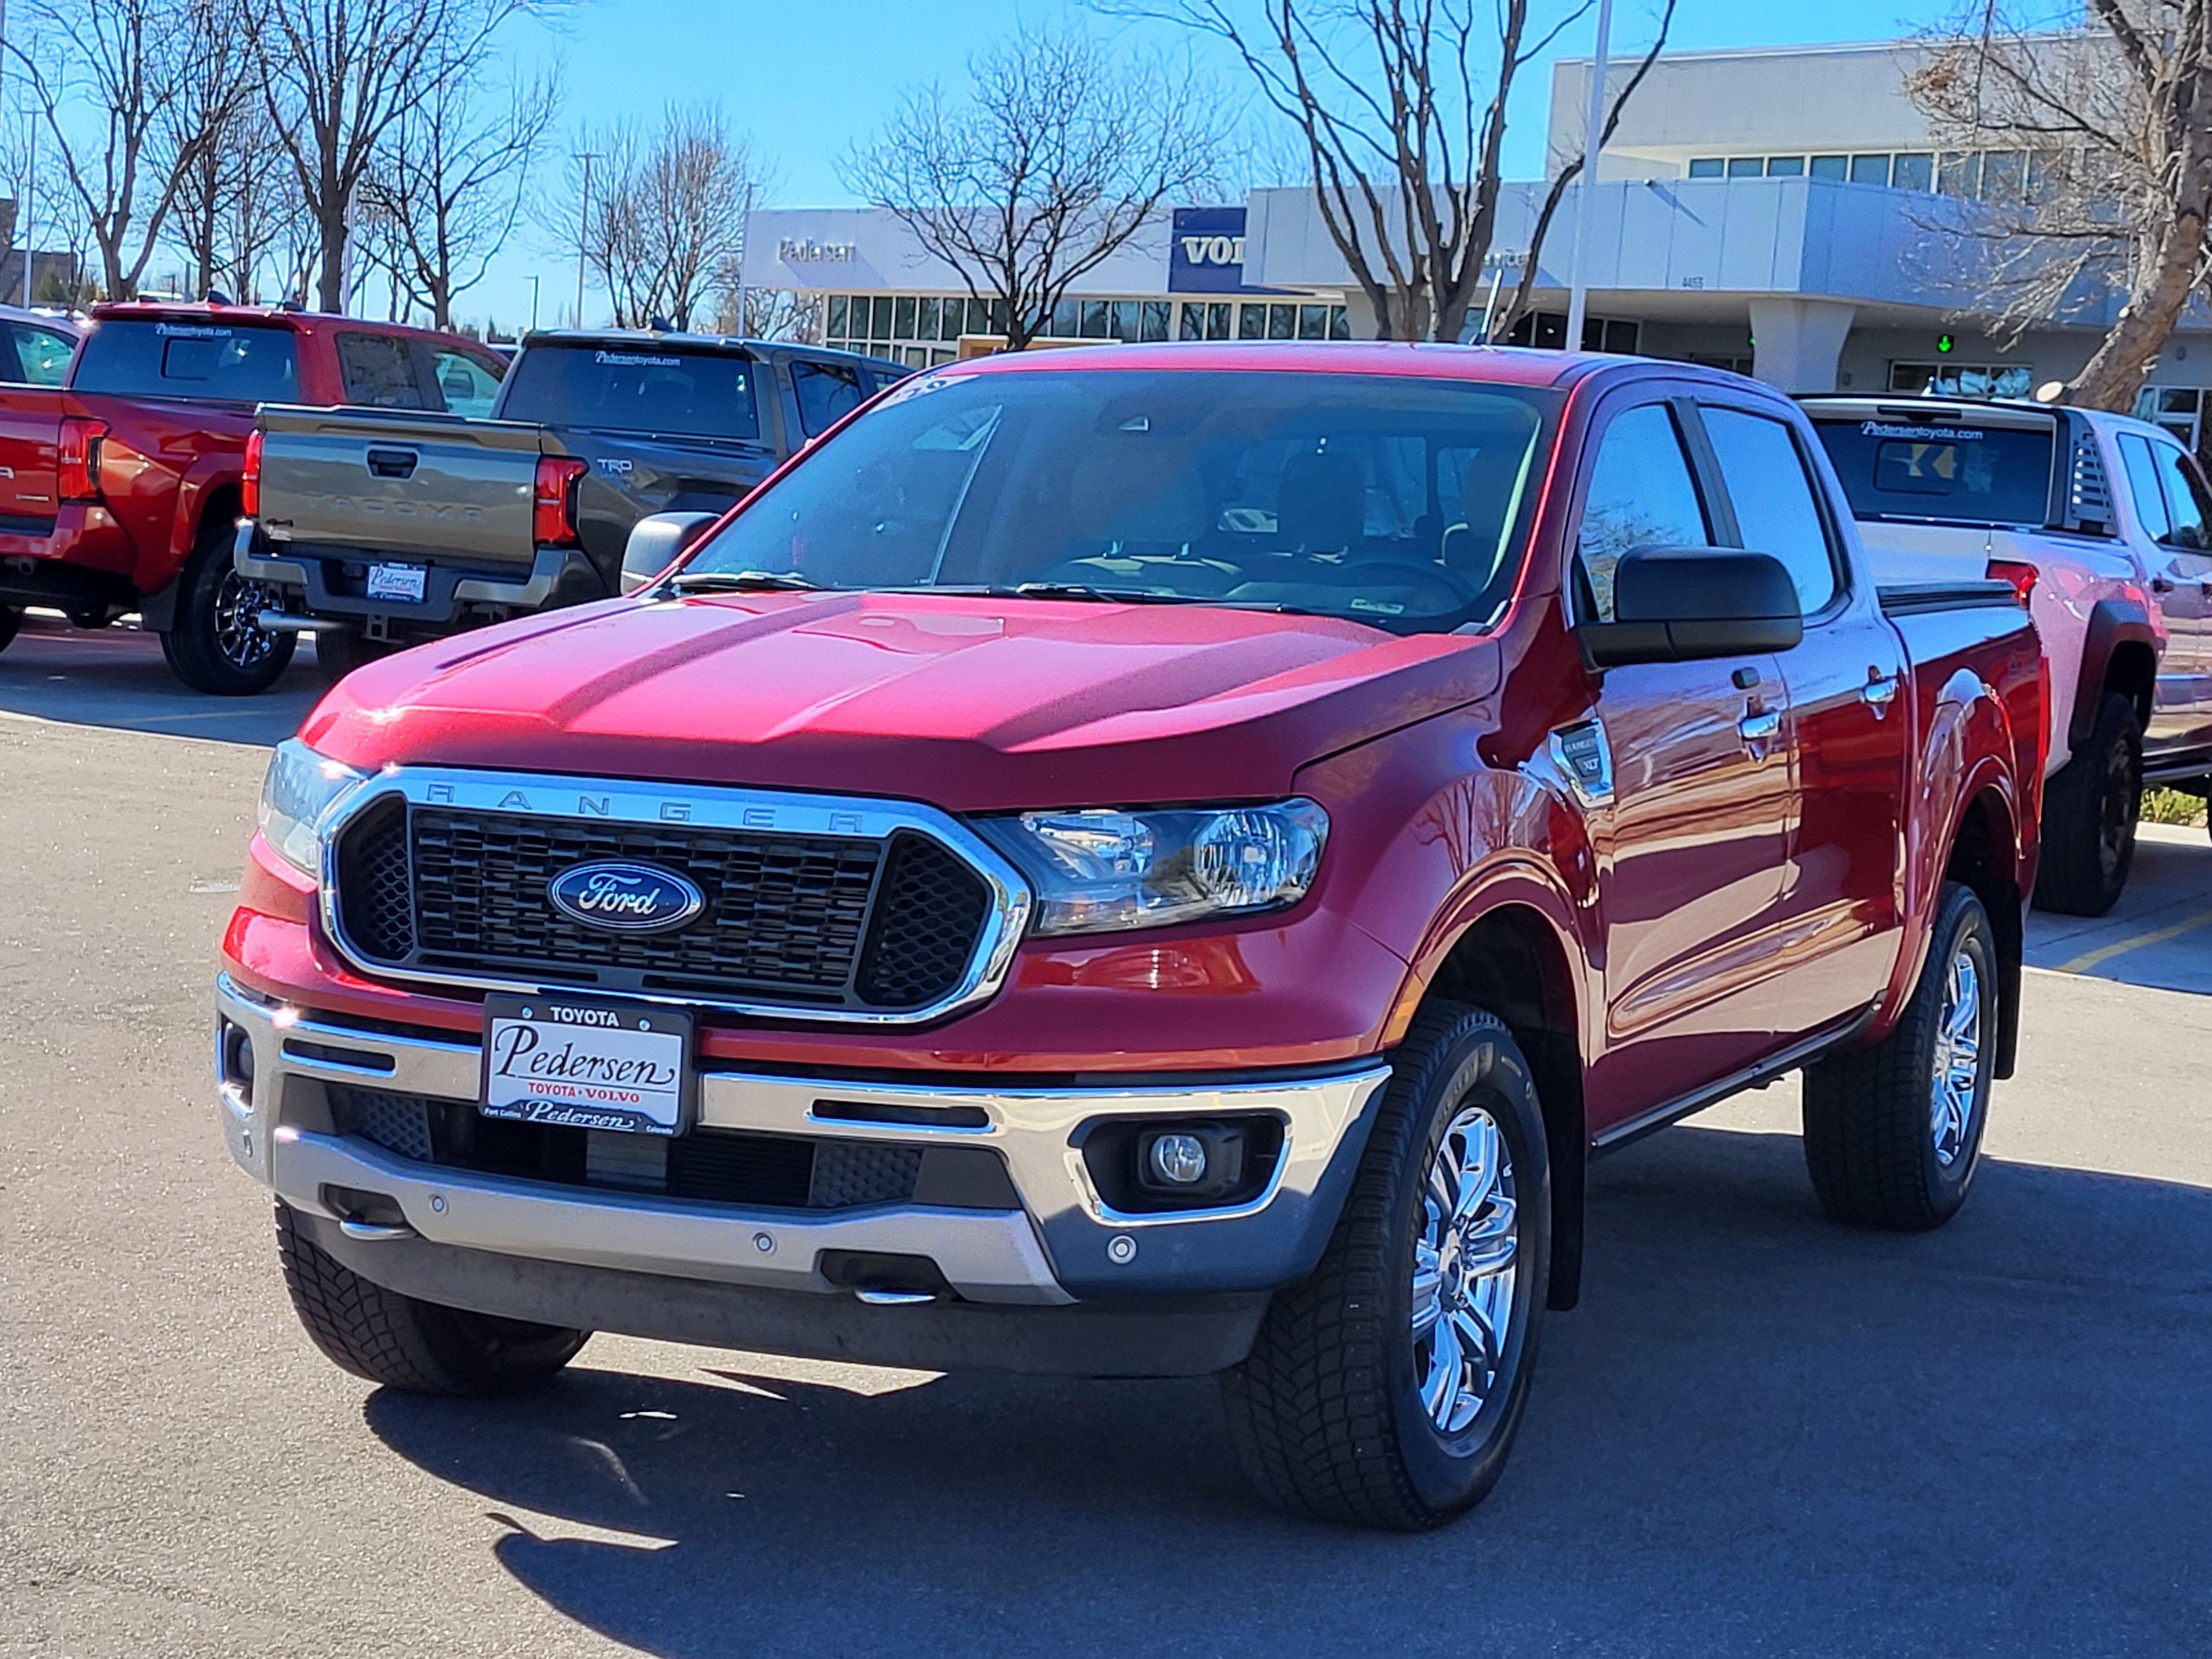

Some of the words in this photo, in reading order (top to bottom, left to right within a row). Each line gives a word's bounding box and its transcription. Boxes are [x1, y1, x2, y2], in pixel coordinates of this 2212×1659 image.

[597, 458, 633, 473] TRD
[303, 492, 487, 523] TACOMA
[1583, 758, 1599, 770] XLT
[427, 784, 864, 833] RANGER
[578, 872, 658, 915] Ford
[550, 1006, 619, 1027] TOYOTA
[495, 1025, 675, 1085] Pedersen
[528, 1082, 576, 1097] TOYOTA
[584, 1088, 639, 1103] VOLVO
[525, 1101, 635, 1128] Pedersen
